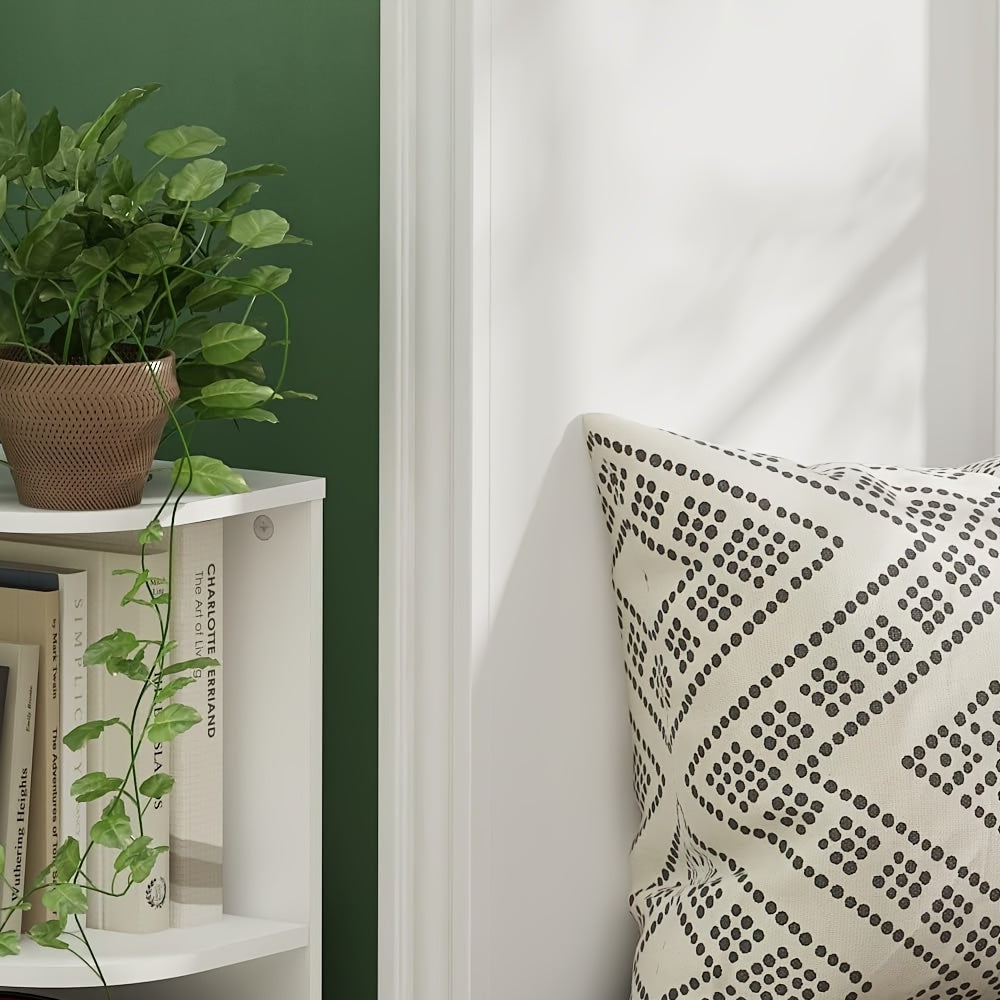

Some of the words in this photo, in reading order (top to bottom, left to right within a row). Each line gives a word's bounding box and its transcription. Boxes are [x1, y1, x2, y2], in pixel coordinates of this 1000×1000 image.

[195, 570, 204, 595] The
[195, 600, 204, 618] Art
[195, 622, 204, 635] of
[207, 563, 216, 655] CHARLOTTE
[193, 640, 204, 679] Livg
[73, 598, 83, 773] SIMPLICY
[207, 669, 216, 738] ERRIAND
[16, 767, 28, 822] Heights
[52, 827, 58, 838] of
[11, 827, 25, 901] Wuthering
